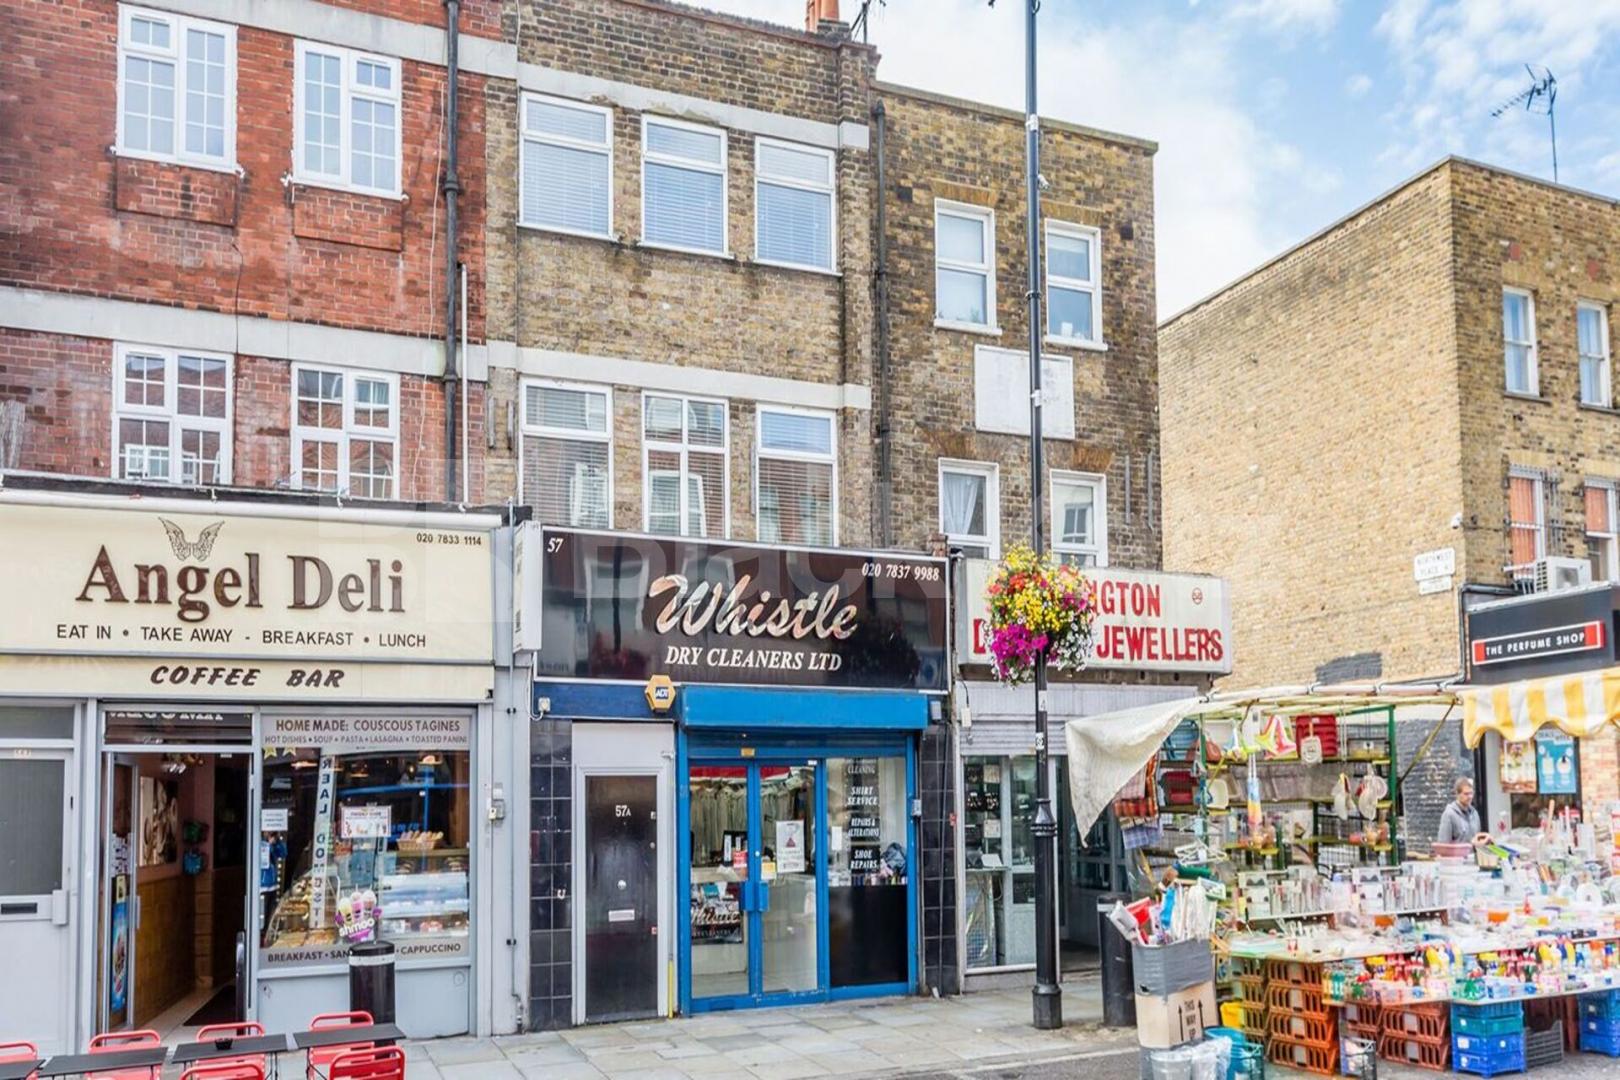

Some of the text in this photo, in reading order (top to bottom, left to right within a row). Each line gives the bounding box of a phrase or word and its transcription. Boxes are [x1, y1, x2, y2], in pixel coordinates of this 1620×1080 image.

[417, 532, 482, 546] 020 7833 1114
[547, 537, 564, 552] 57
[861, 562, 940, 580] 020 7837 9988
[75, 544, 406, 623] Angel Deli
[649, 573, 860, 640] Whistle
[57, 623, 426, 648] EAT IN TAKE AWAY BREAKFAST LUNCH
[1096, 624, 1224, 661] JEWELLERS
[1485, 631, 1585, 656] THE PERFUME SHOP
[665, 645, 842, 671] DRY CLEANERS LTD
[150, 664, 346, 688] COFFEE BAR
[276, 719, 461, 732] HOME MADE: COUSCOUS TAGINES
[264, 735, 281, 744] HOT
[282, 735, 307, 744] DISHES
[313, 735, 334, 744] SOUP
[341, 735, 365, 743] PASTA
[370, 735, 404, 743] LASAGNA
[411, 735, 441, 743] TOASTED
[850, 785, 874, 795] SHIRT
[847, 796, 878, 806] SERVICE
[850, 817, 872, 827] REPAIRS
[847, 828, 880, 838] ALTERATIONS
[854, 849, 873, 859] SHOE
[850, 860, 878, 870] REPAIRS
[338, 918, 375, 936] shmoo
[268, 943, 462, 962] BREAKFAST SAN CAPPUCCINO
